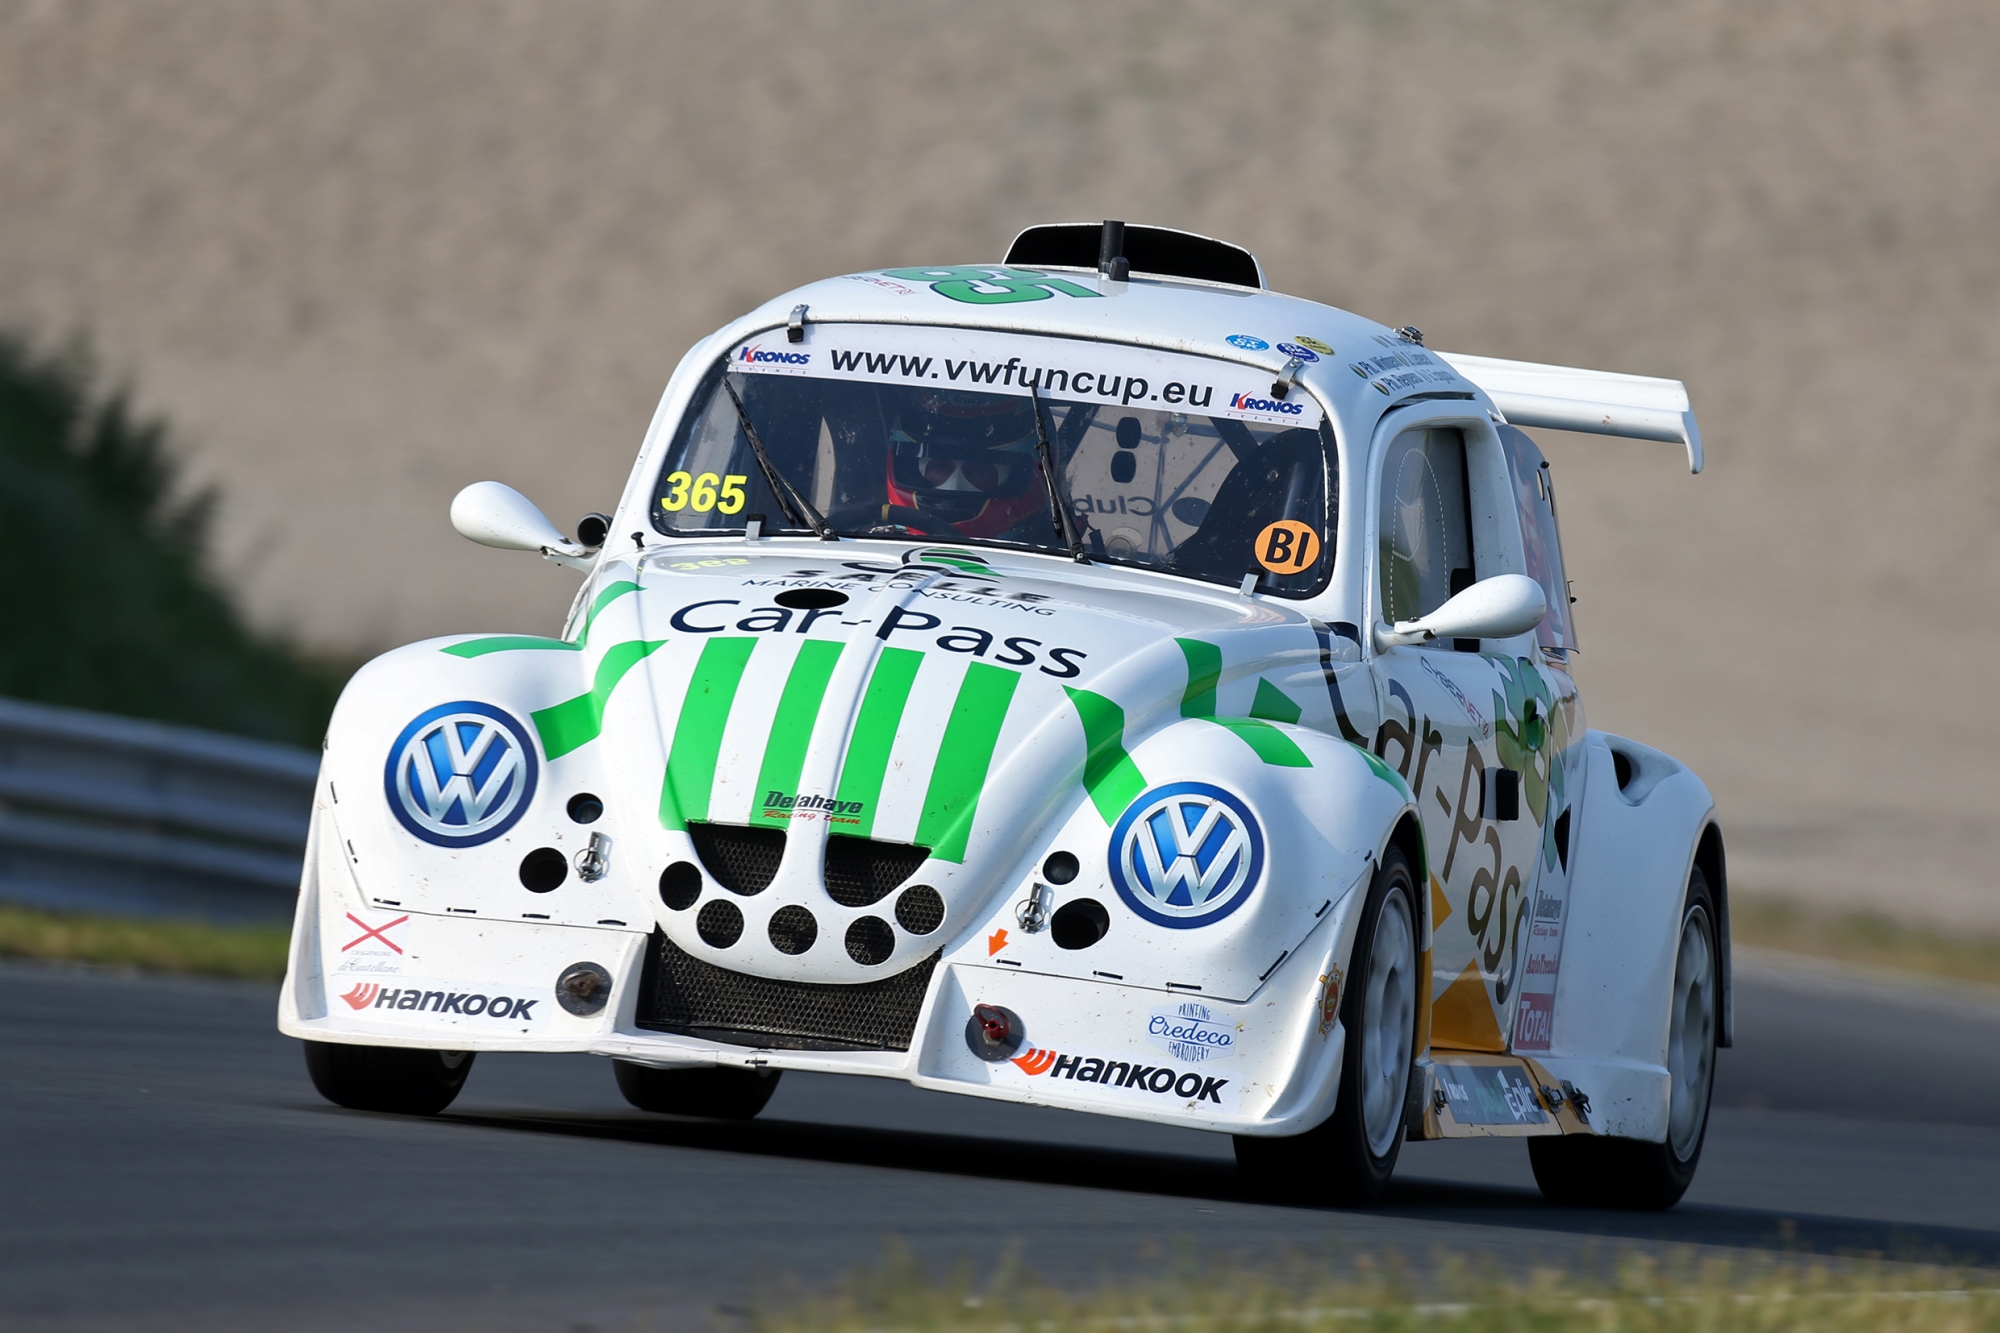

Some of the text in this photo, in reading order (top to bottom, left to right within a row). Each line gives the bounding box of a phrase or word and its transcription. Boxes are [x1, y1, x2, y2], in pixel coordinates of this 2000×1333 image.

[738, 344, 811, 365] KRONOS
[830, 349, 1213, 407] www.vwfuncup.eu
[1229, 391, 1304, 415] KRONOS
[1226, 412, 1300, 425] EVENTS
[661, 471, 748, 515] 365
[1265, 527, 1311, 567] BI
[741, 578, 1057, 617] MARINE CONSULTING
[669, 600, 1088, 679] Car-Pass
[763, 790, 864, 814] Delahaye
[763, 810, 861, 825] Racing team
[1178, 1002, 1211, 1020] PRINTING
[1148, 1014, 1234, 1047] Credeco
[1168, 1041, 1210, 1063] EMBROIDERY
